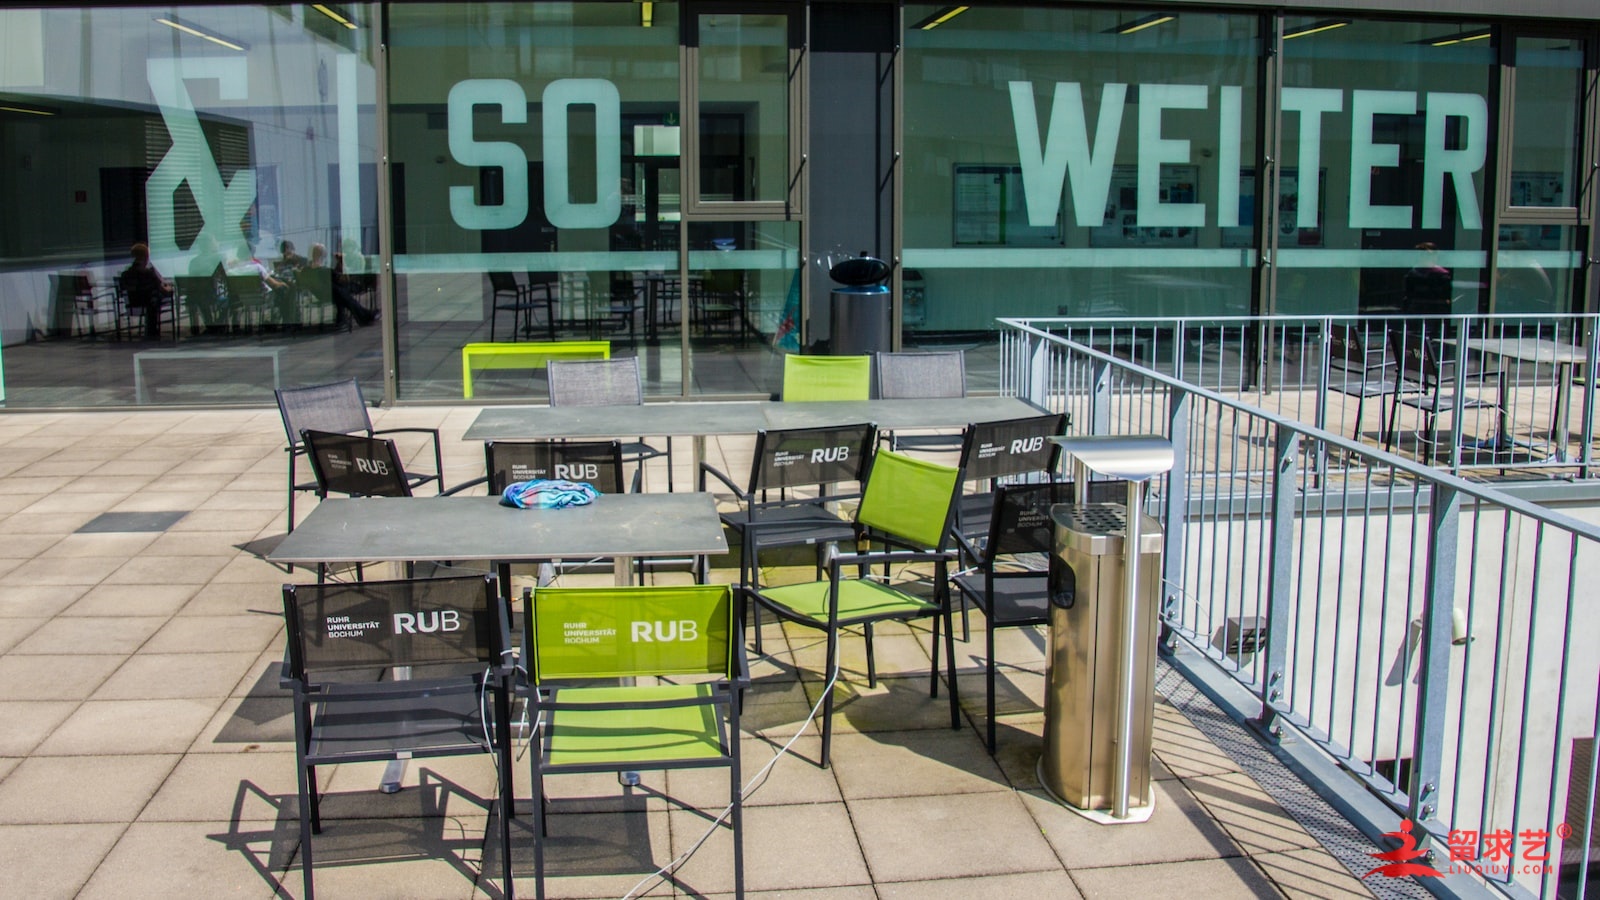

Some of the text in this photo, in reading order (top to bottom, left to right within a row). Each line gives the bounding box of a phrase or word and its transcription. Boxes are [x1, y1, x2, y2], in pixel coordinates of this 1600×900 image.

[448, 78, 621, 230] SO
[1008, 80, 1489, 230] WEITER
[1010, 436, 1044, 455] RUB
[810, 446, 849, 464] RUB
[356, 457, 389, 476] RUB
[554, 464, 598, 479] RUB
[327, 621, 380, 631] UNIVERSITÄT
[393, 610, 460, 635] RUB
[631, 620, 698, 642] RUB
[328, 630, 363, 639] BOCHUM
[564, 628, 617, 637] UNIVERSITÄT
